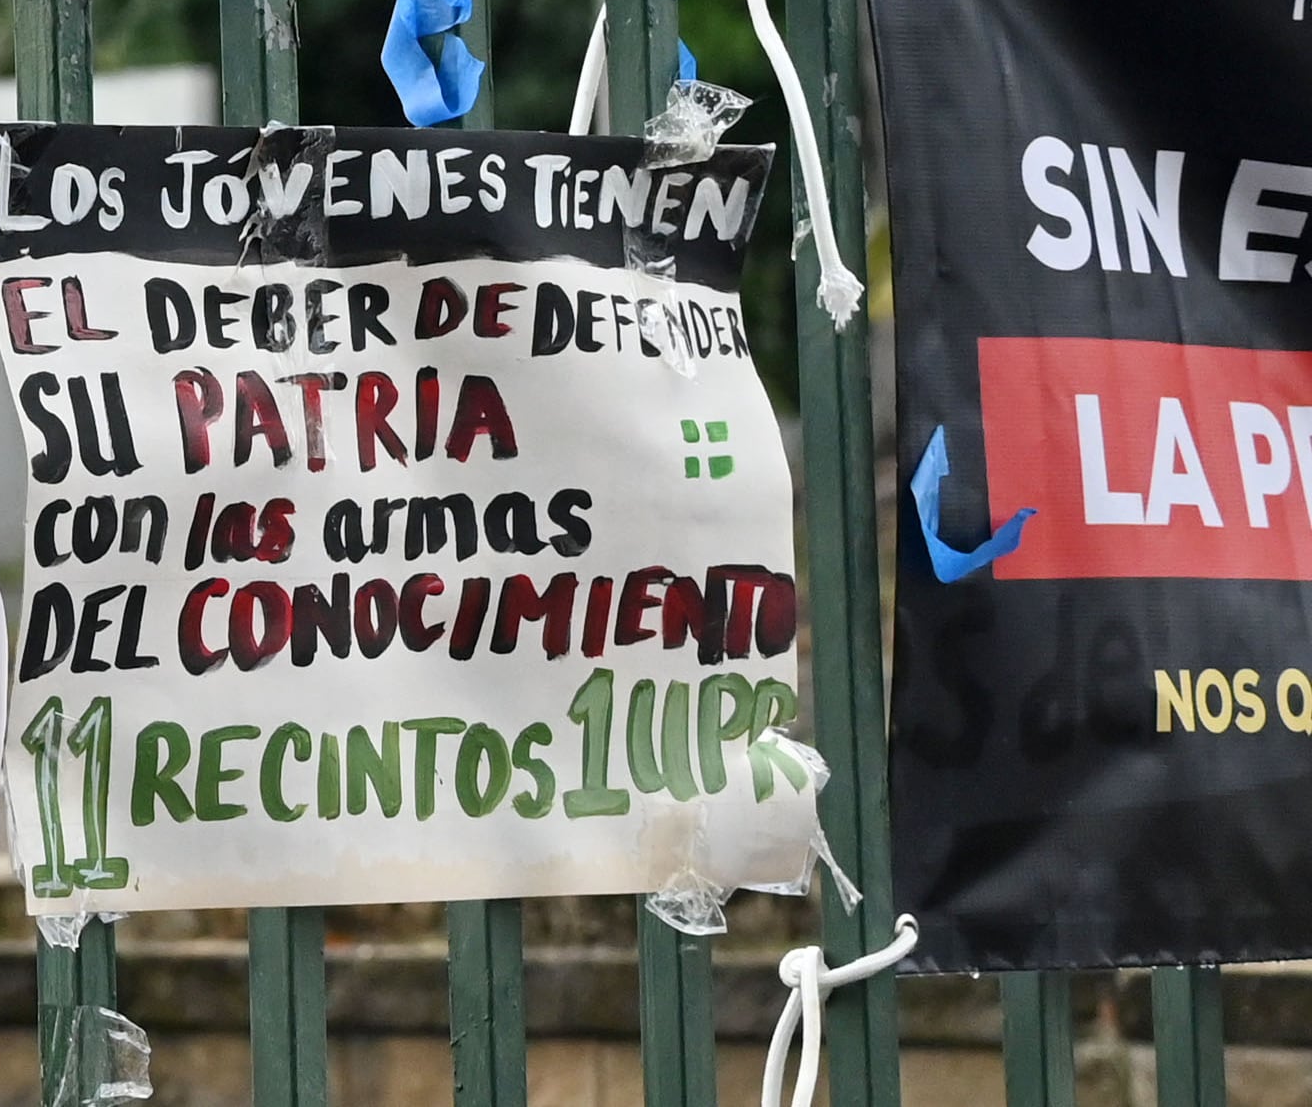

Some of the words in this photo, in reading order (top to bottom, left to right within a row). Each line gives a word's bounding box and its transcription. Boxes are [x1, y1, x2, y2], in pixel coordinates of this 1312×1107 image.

[1021, 135, 1188, 278] SIN
[1218, 158, 1312, 284] E
[0, 277, 118, 354] EL
[145, 277, 398, 354] DEBER
[414, 277, 528, 339] DE
[531, 282, 749, 359] DEFENDER
[19, 371, 143, 483] SU
[172, 367, 519, 472] PATRIA
[1075, 394, 1225, 528] LA
[33, 494, 169, 567] con
[185, 493, 296, 570] las
[322, 488, 593, 562] armas
[19, 582, 160, 682] DEL
[178, 565, 796, 676] CONOCIMIENTO
[1154, 668, 1266, 734] NOS
[20, 696, 129, 898] 11
[130, 719, 557, 825] RECINTOS
